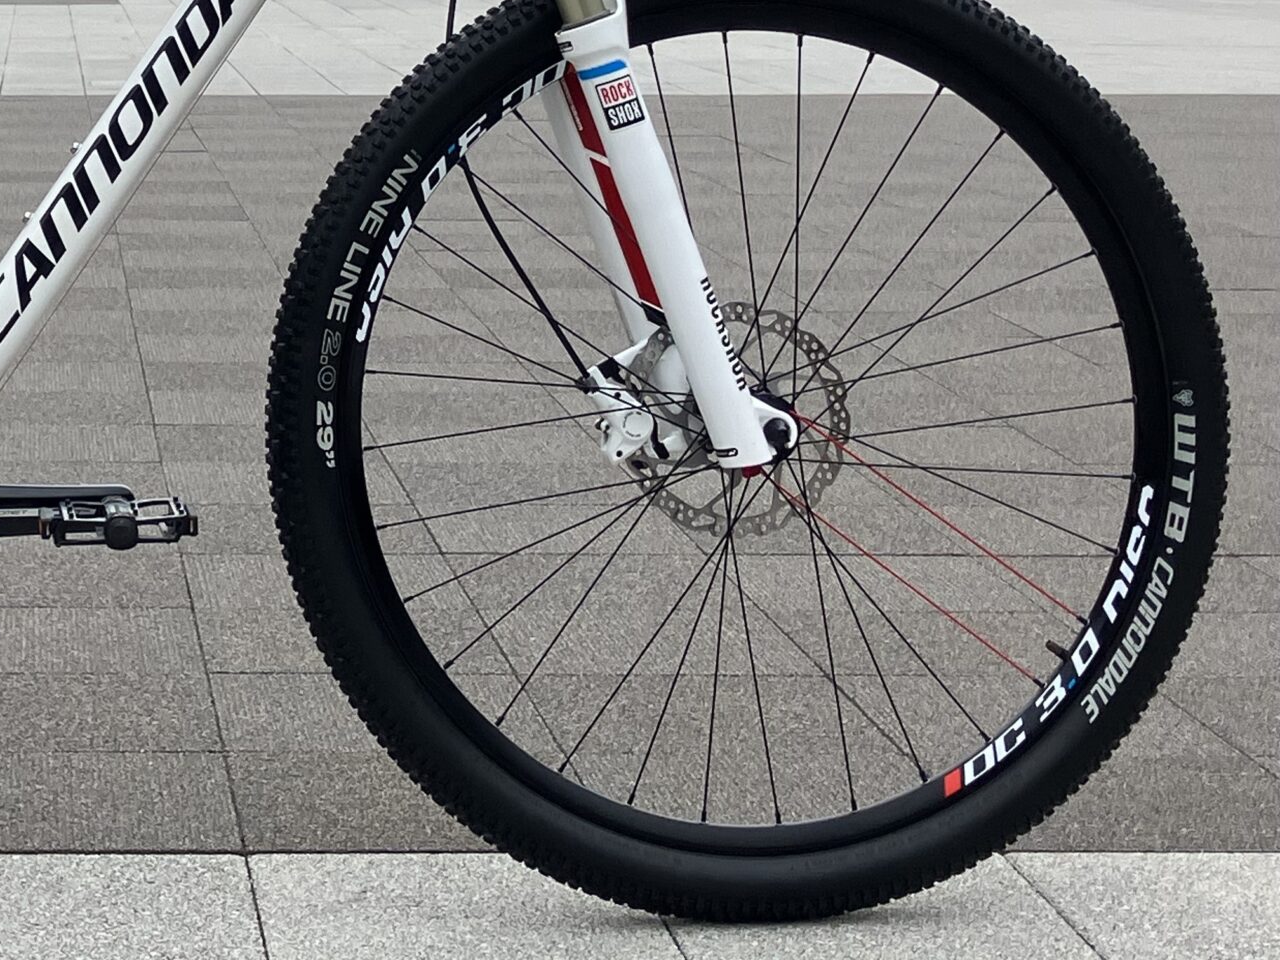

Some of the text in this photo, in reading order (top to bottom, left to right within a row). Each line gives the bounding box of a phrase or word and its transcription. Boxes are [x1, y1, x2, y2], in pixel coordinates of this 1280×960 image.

[501, 59, 567, 118] DC
[600, 80, 634, 105] ROCK
[607, 100, 642, 127] SHOX
[359, 152, 421, 239] NINE
[326, 241, 370, 324] LINE
[316, 328, 341, 391] 2.0
[1080, 413, 1197, 724] WTB CANNONDALE
[1034, 626, 1101, 722] 3.0
[963, 717, 1026, 788] DC
